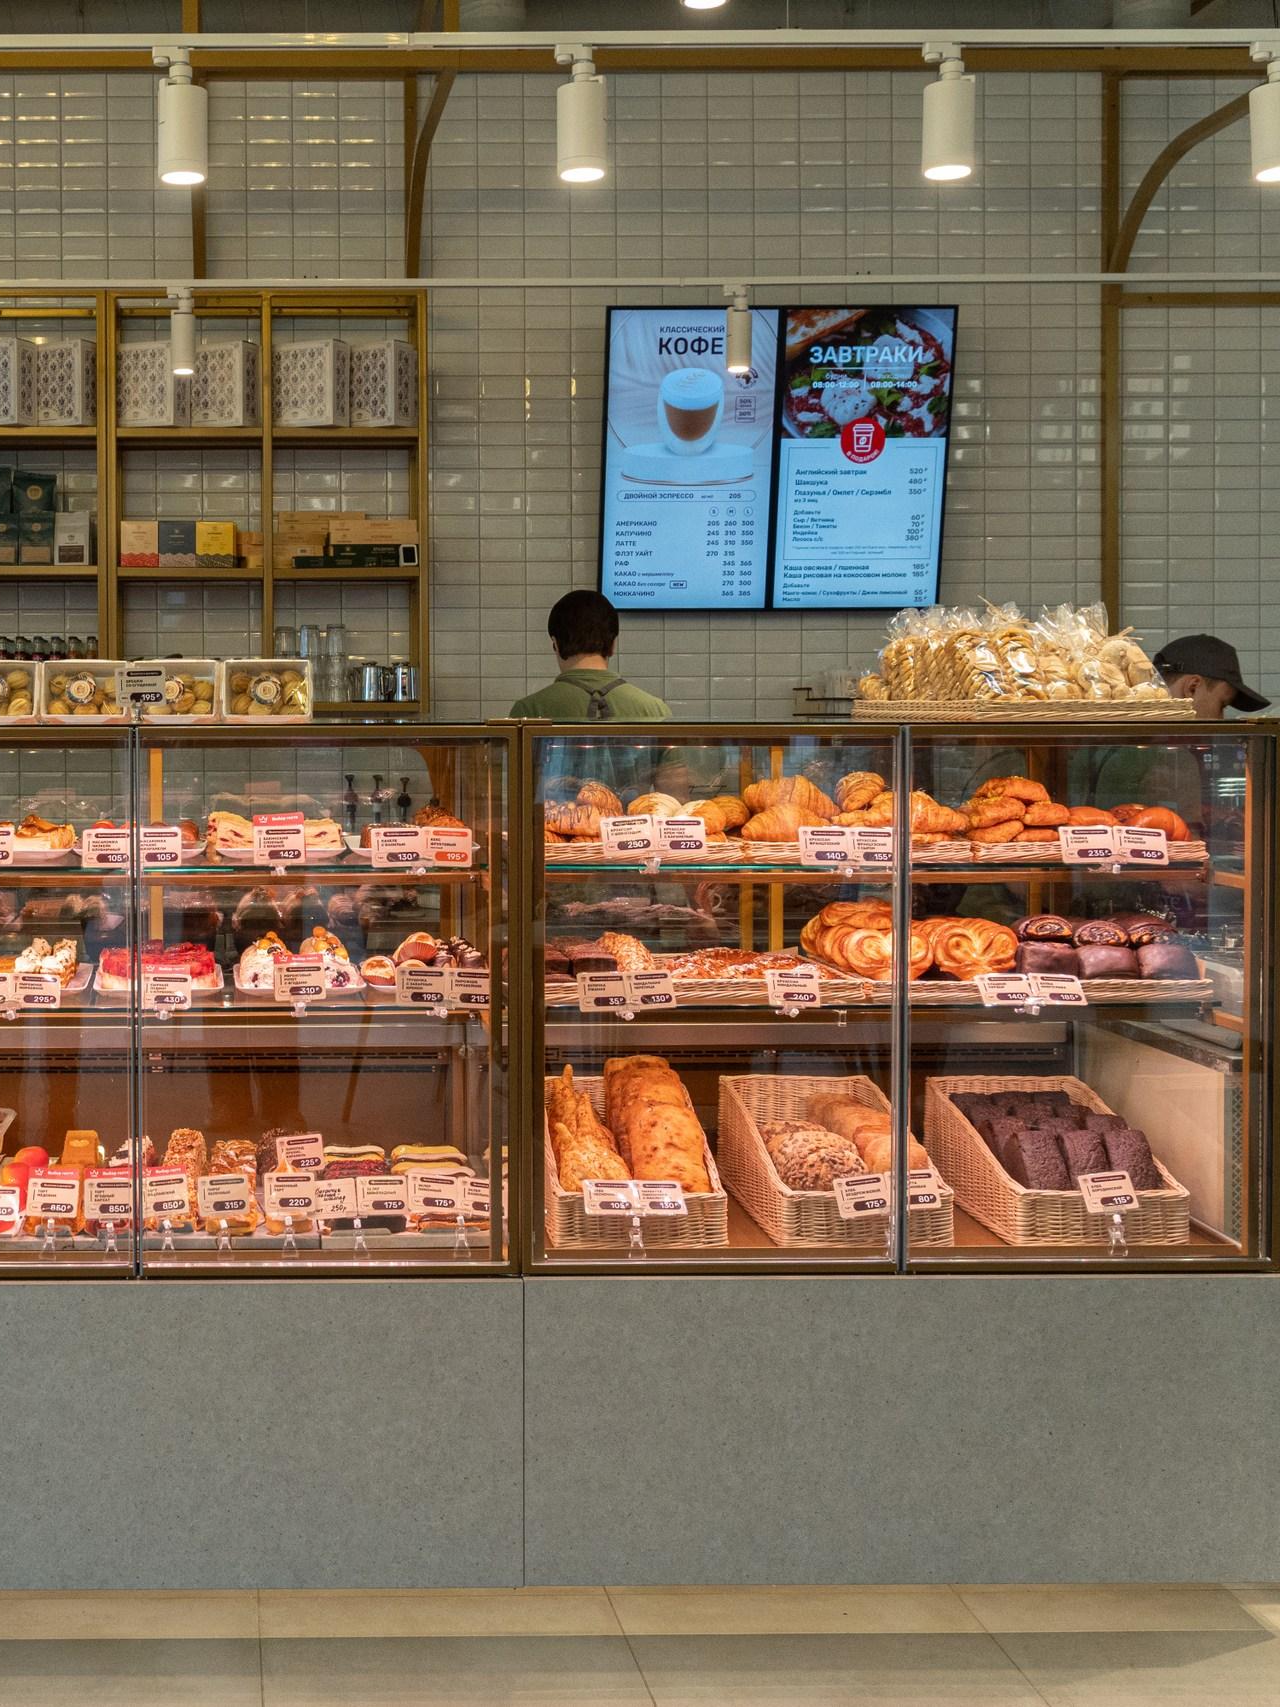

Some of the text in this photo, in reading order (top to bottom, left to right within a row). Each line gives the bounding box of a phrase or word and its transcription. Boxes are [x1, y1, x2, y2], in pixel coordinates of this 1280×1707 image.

[660, 325, 725, 333] КЛАССИЧЕСКИЙ
[659, 336, 723, 355] КОФЕ
[809, 345, 924, 363] ЗАВТРАКИ
[795, 468, 867, 477] Английский завтрак
[795, 479, 829, 487] Шакшука
[624, 492, 657, 500] ДВОЙНОЙ
[860, 488, 892, 497] Скрэмбл
[634, 549, 653, 557] УАЙТ
[803, 572, 832, 580] рисовая
